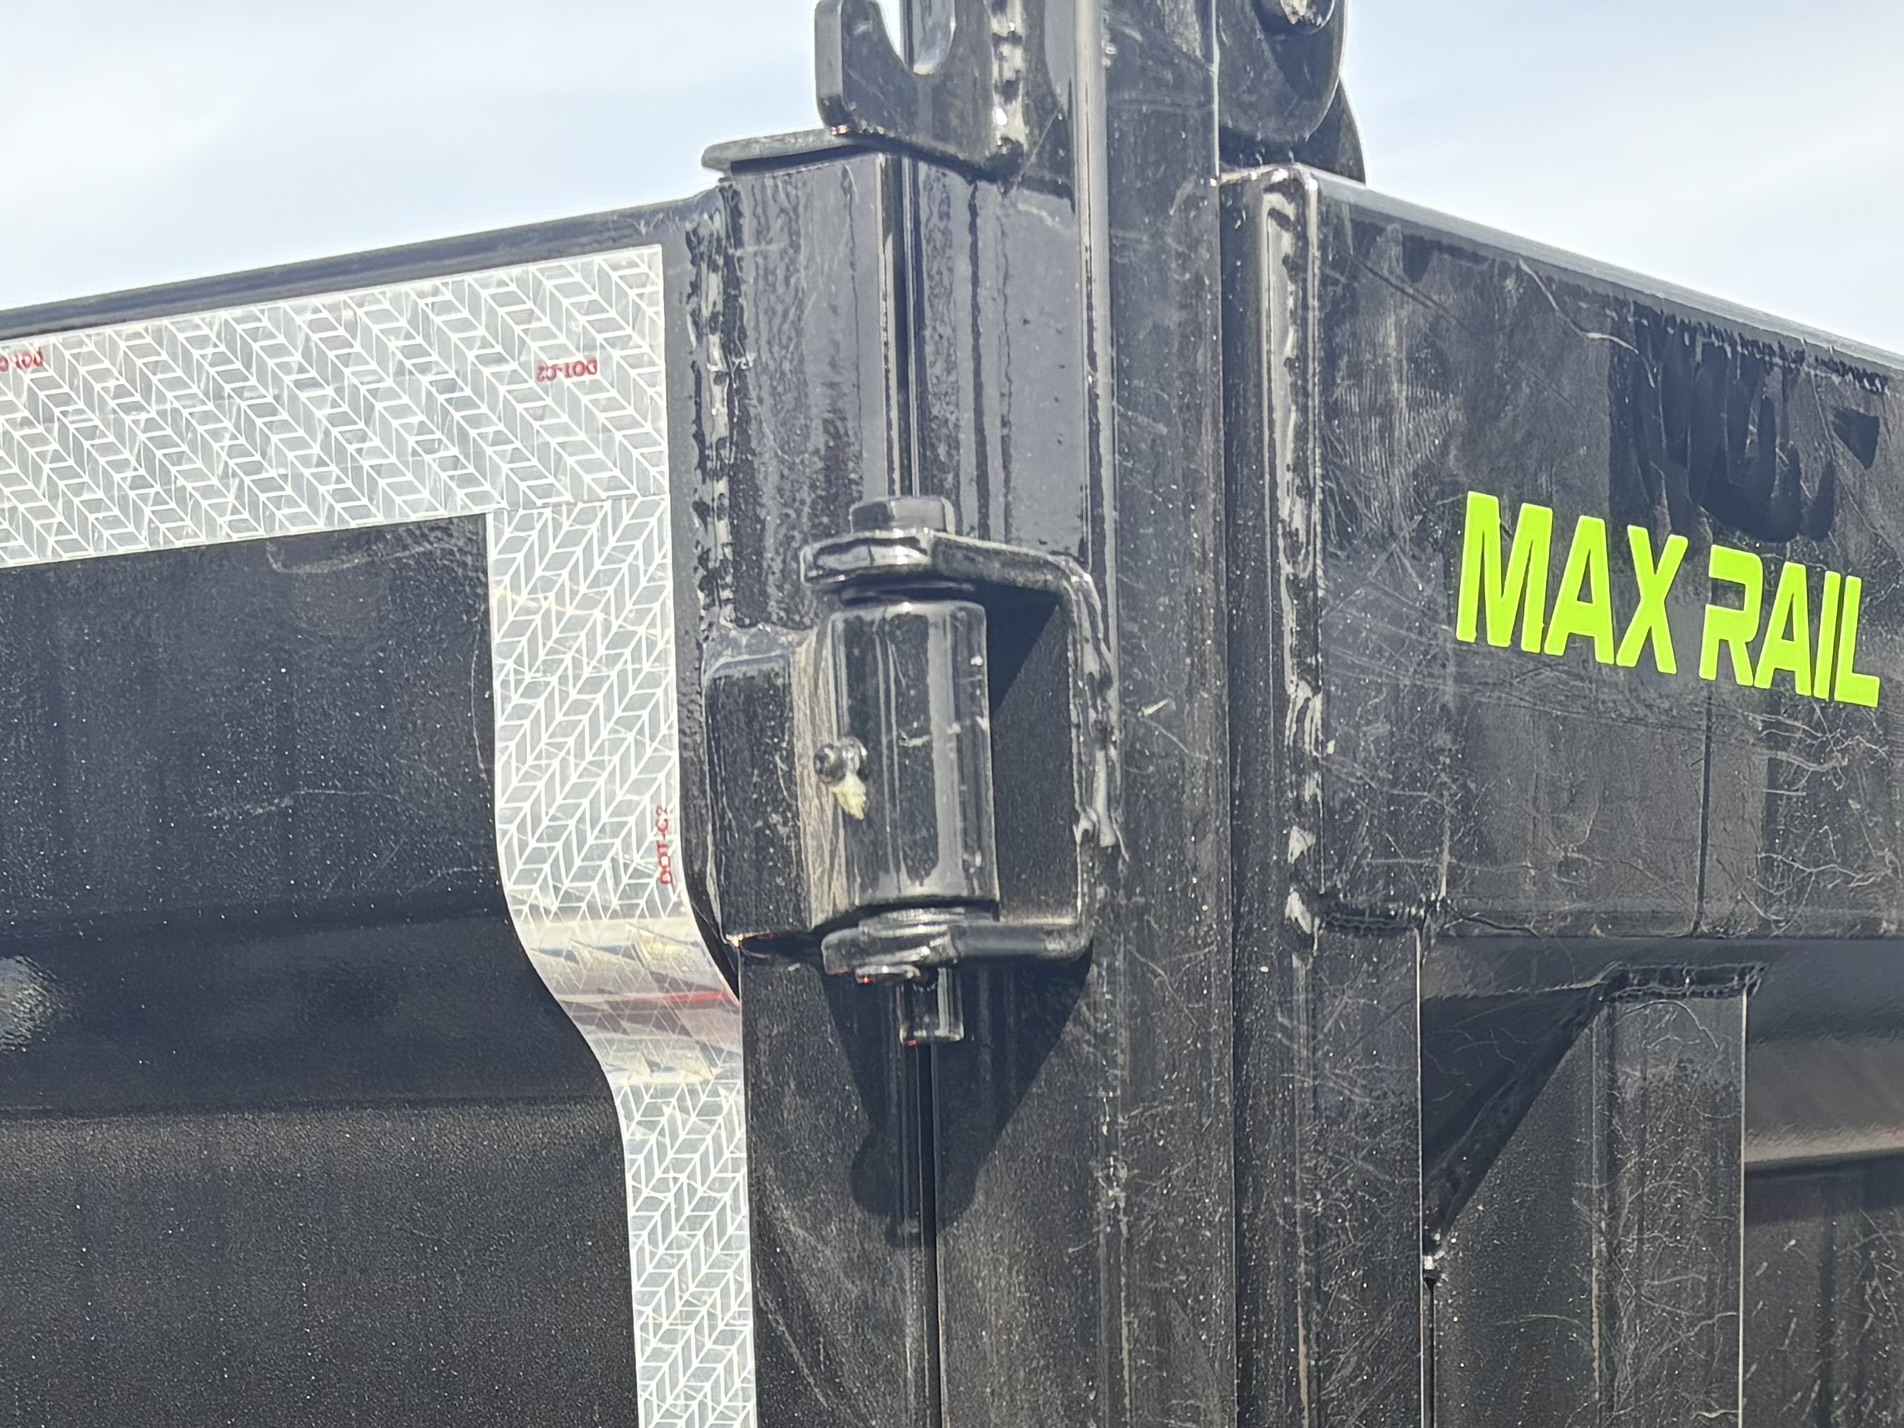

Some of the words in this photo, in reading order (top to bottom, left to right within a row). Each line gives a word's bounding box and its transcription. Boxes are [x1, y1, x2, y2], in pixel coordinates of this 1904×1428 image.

[536, 356, 598, 382] DOT-C2
[1456, 491, 1688, 675] MAX
[1699, 545, 1880, 708] RAIL
[656, 803, 674, 885] DOT-C2
